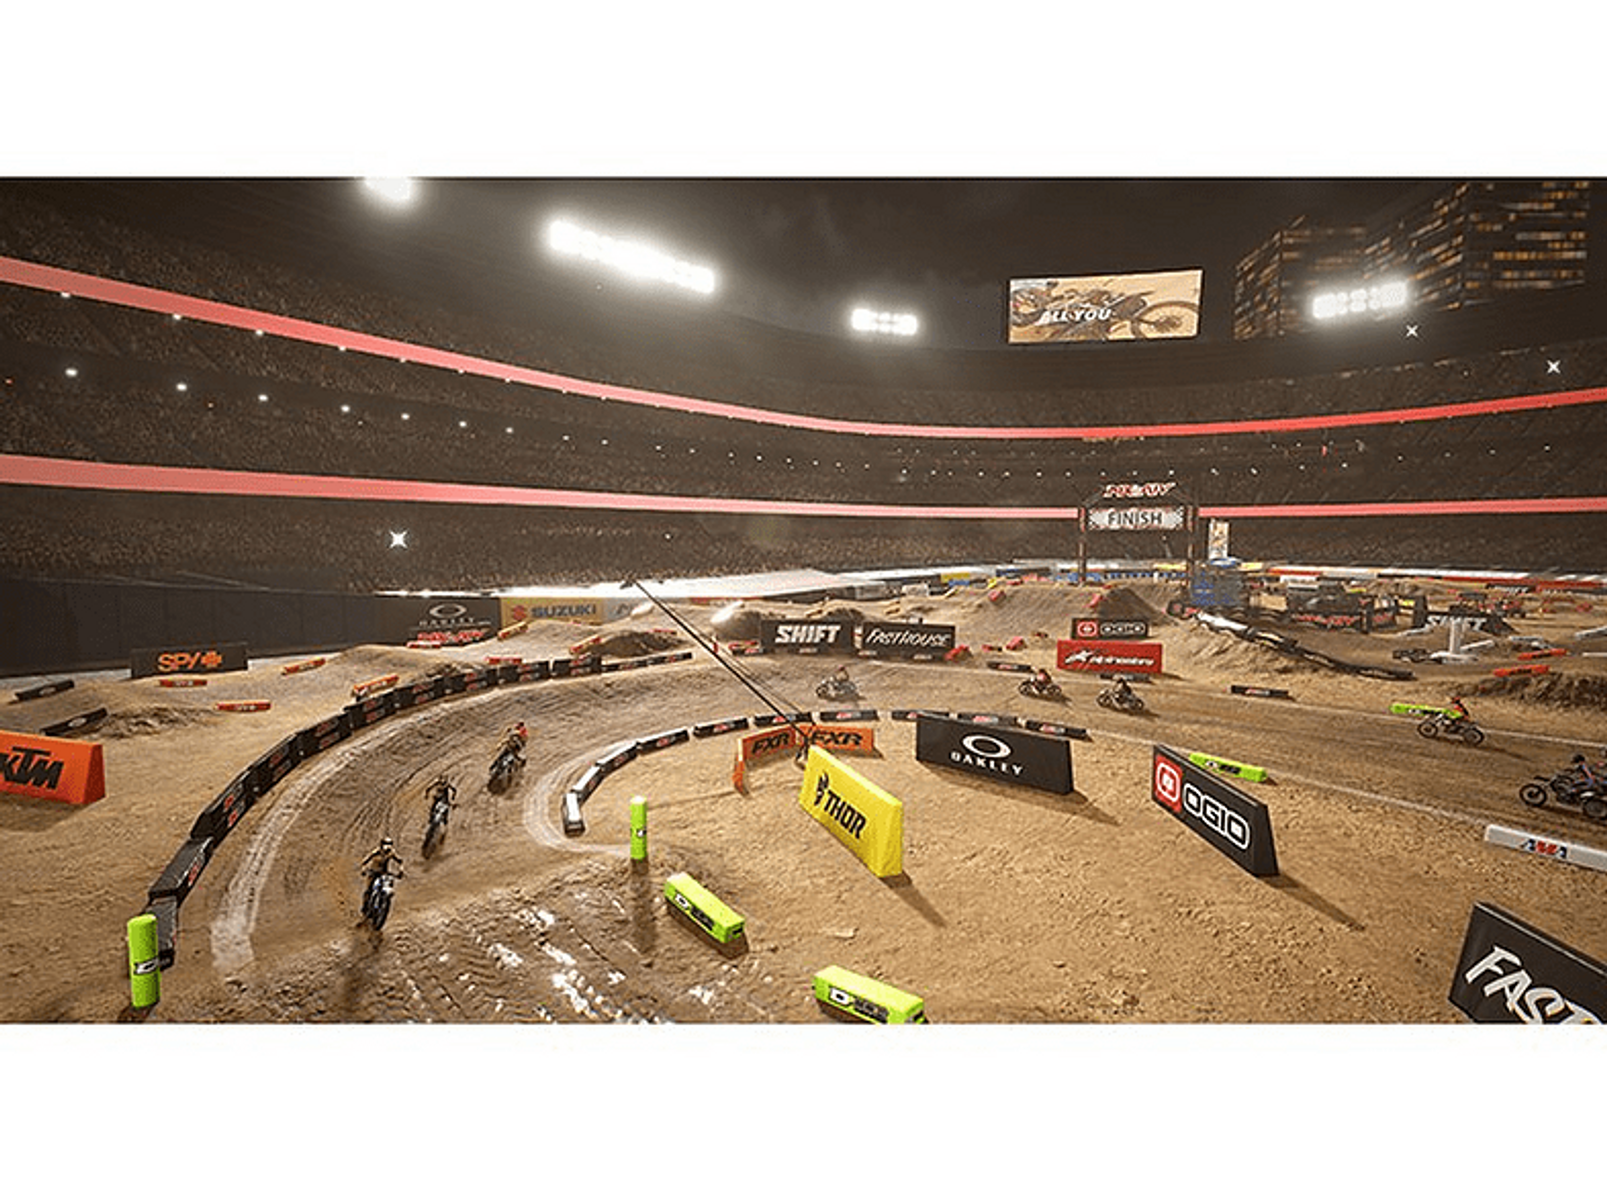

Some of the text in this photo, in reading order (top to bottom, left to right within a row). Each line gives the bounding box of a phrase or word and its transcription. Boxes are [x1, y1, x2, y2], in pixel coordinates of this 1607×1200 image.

[1107, 511, 1162, 525] FINISH
[530, 604, 596, 617] SUZUKI
[775, 625, 841, 643] SHIFT
[158, 652, 200, 671] SPY
[752, 733, 790, 754] FXR
[811, 731, 862, 746] FXR
[0, 747, 64, 790] KTM
[950, 751, 1023, 776] OAKLEY
[824, 789, 866, 839] THOR
[1182, 782, 1250, 850] OGIO
